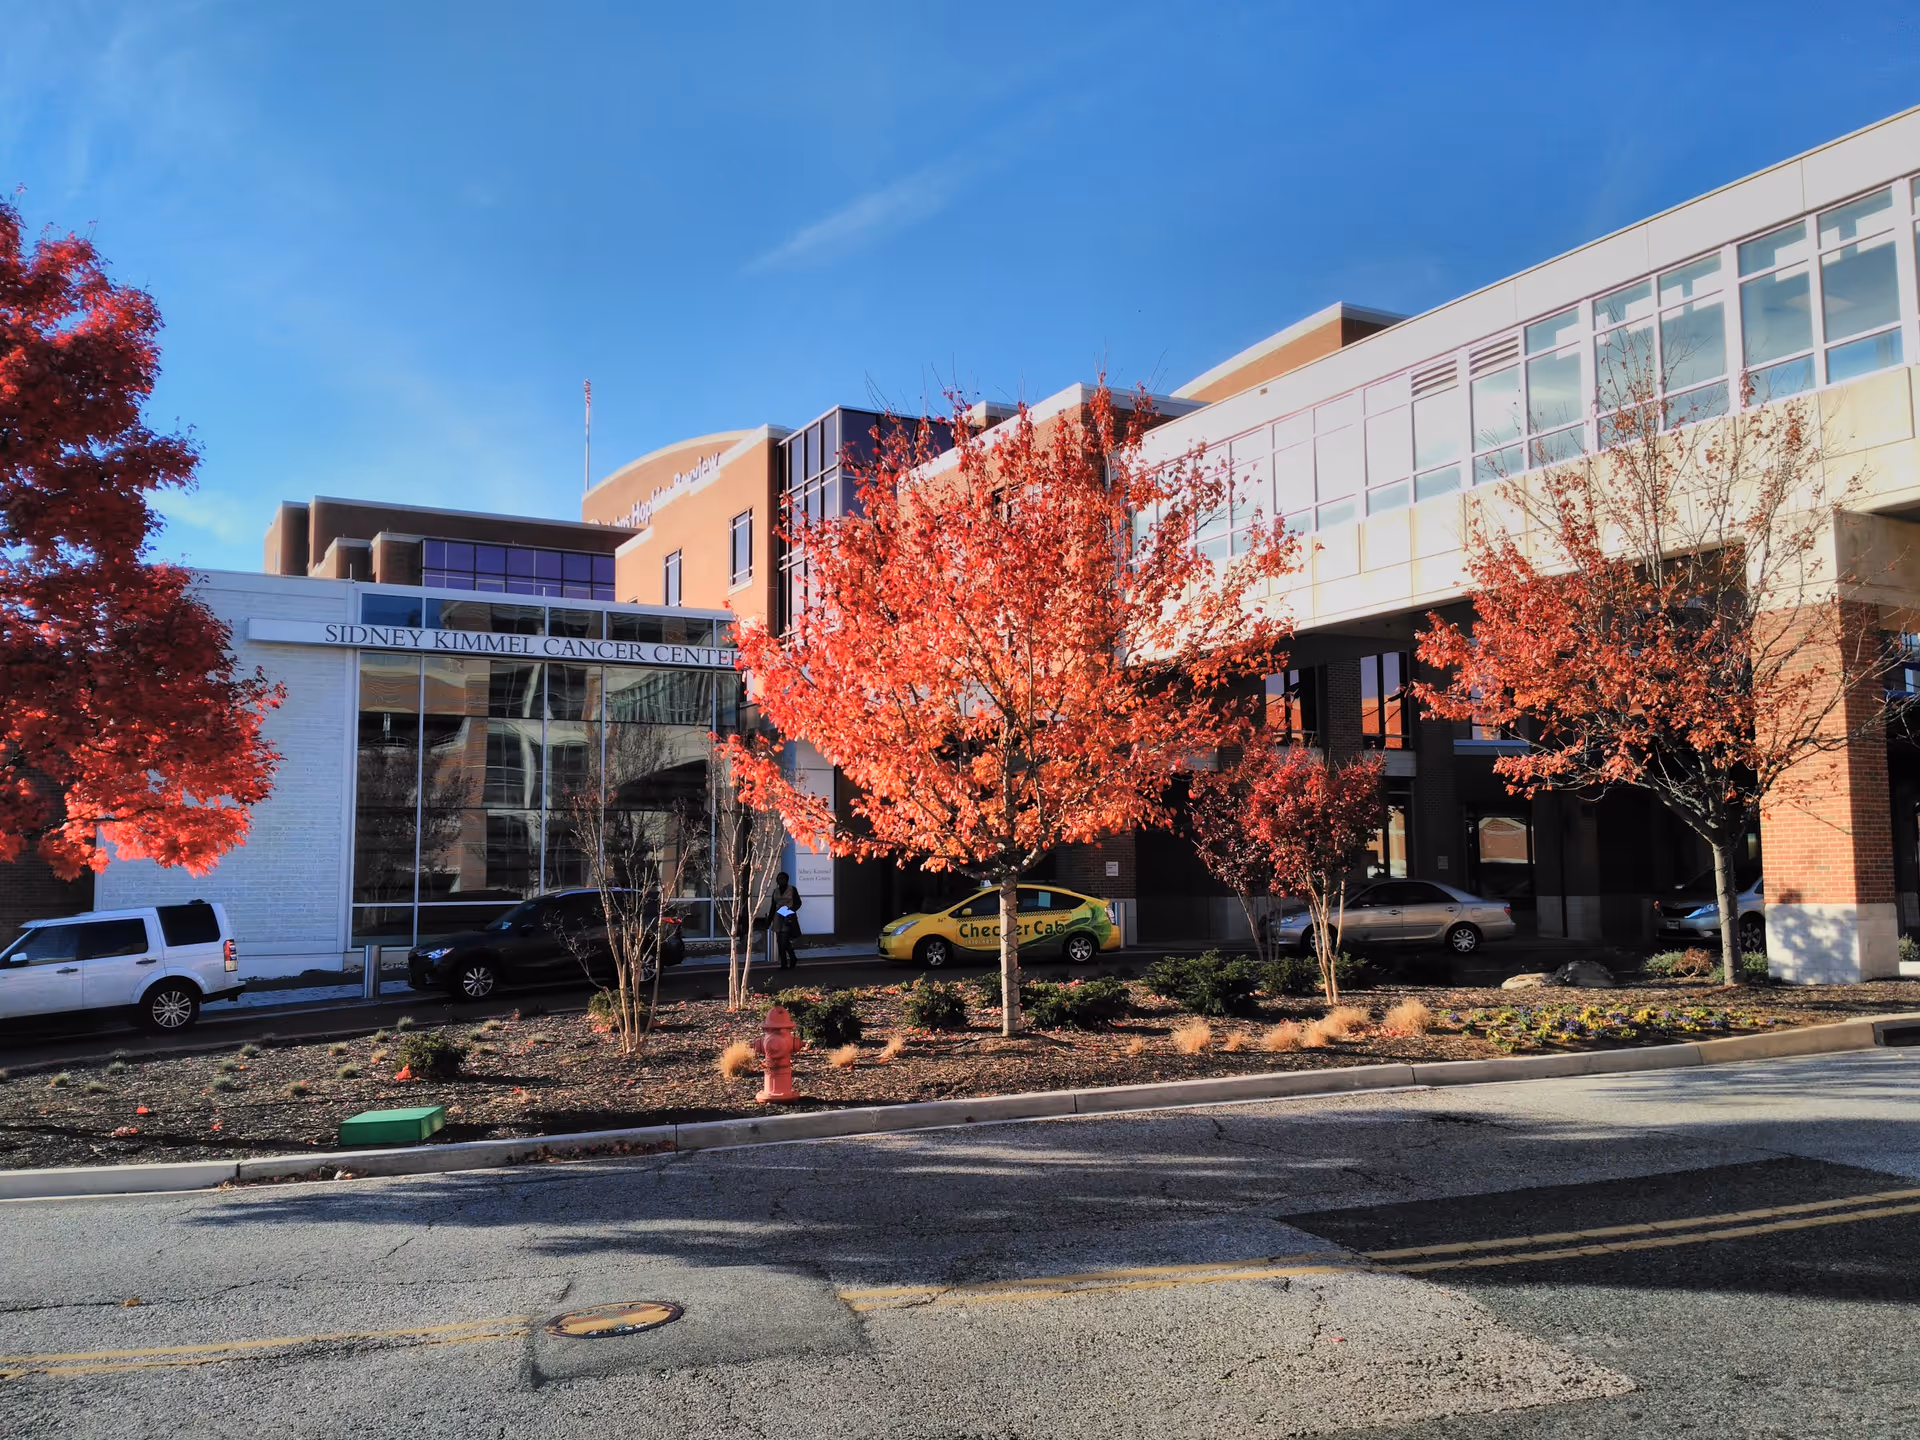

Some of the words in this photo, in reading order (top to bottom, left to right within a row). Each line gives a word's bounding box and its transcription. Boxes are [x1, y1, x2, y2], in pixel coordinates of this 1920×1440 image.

[325, 624, 425, 647] SIDNEY
[433, 631, 535, 654] KIMMEL
[543, 638, 646, 661] CANCER
[959, 923, 1030, 938] Checer
[1034, 920, 1066, 935] Cab
